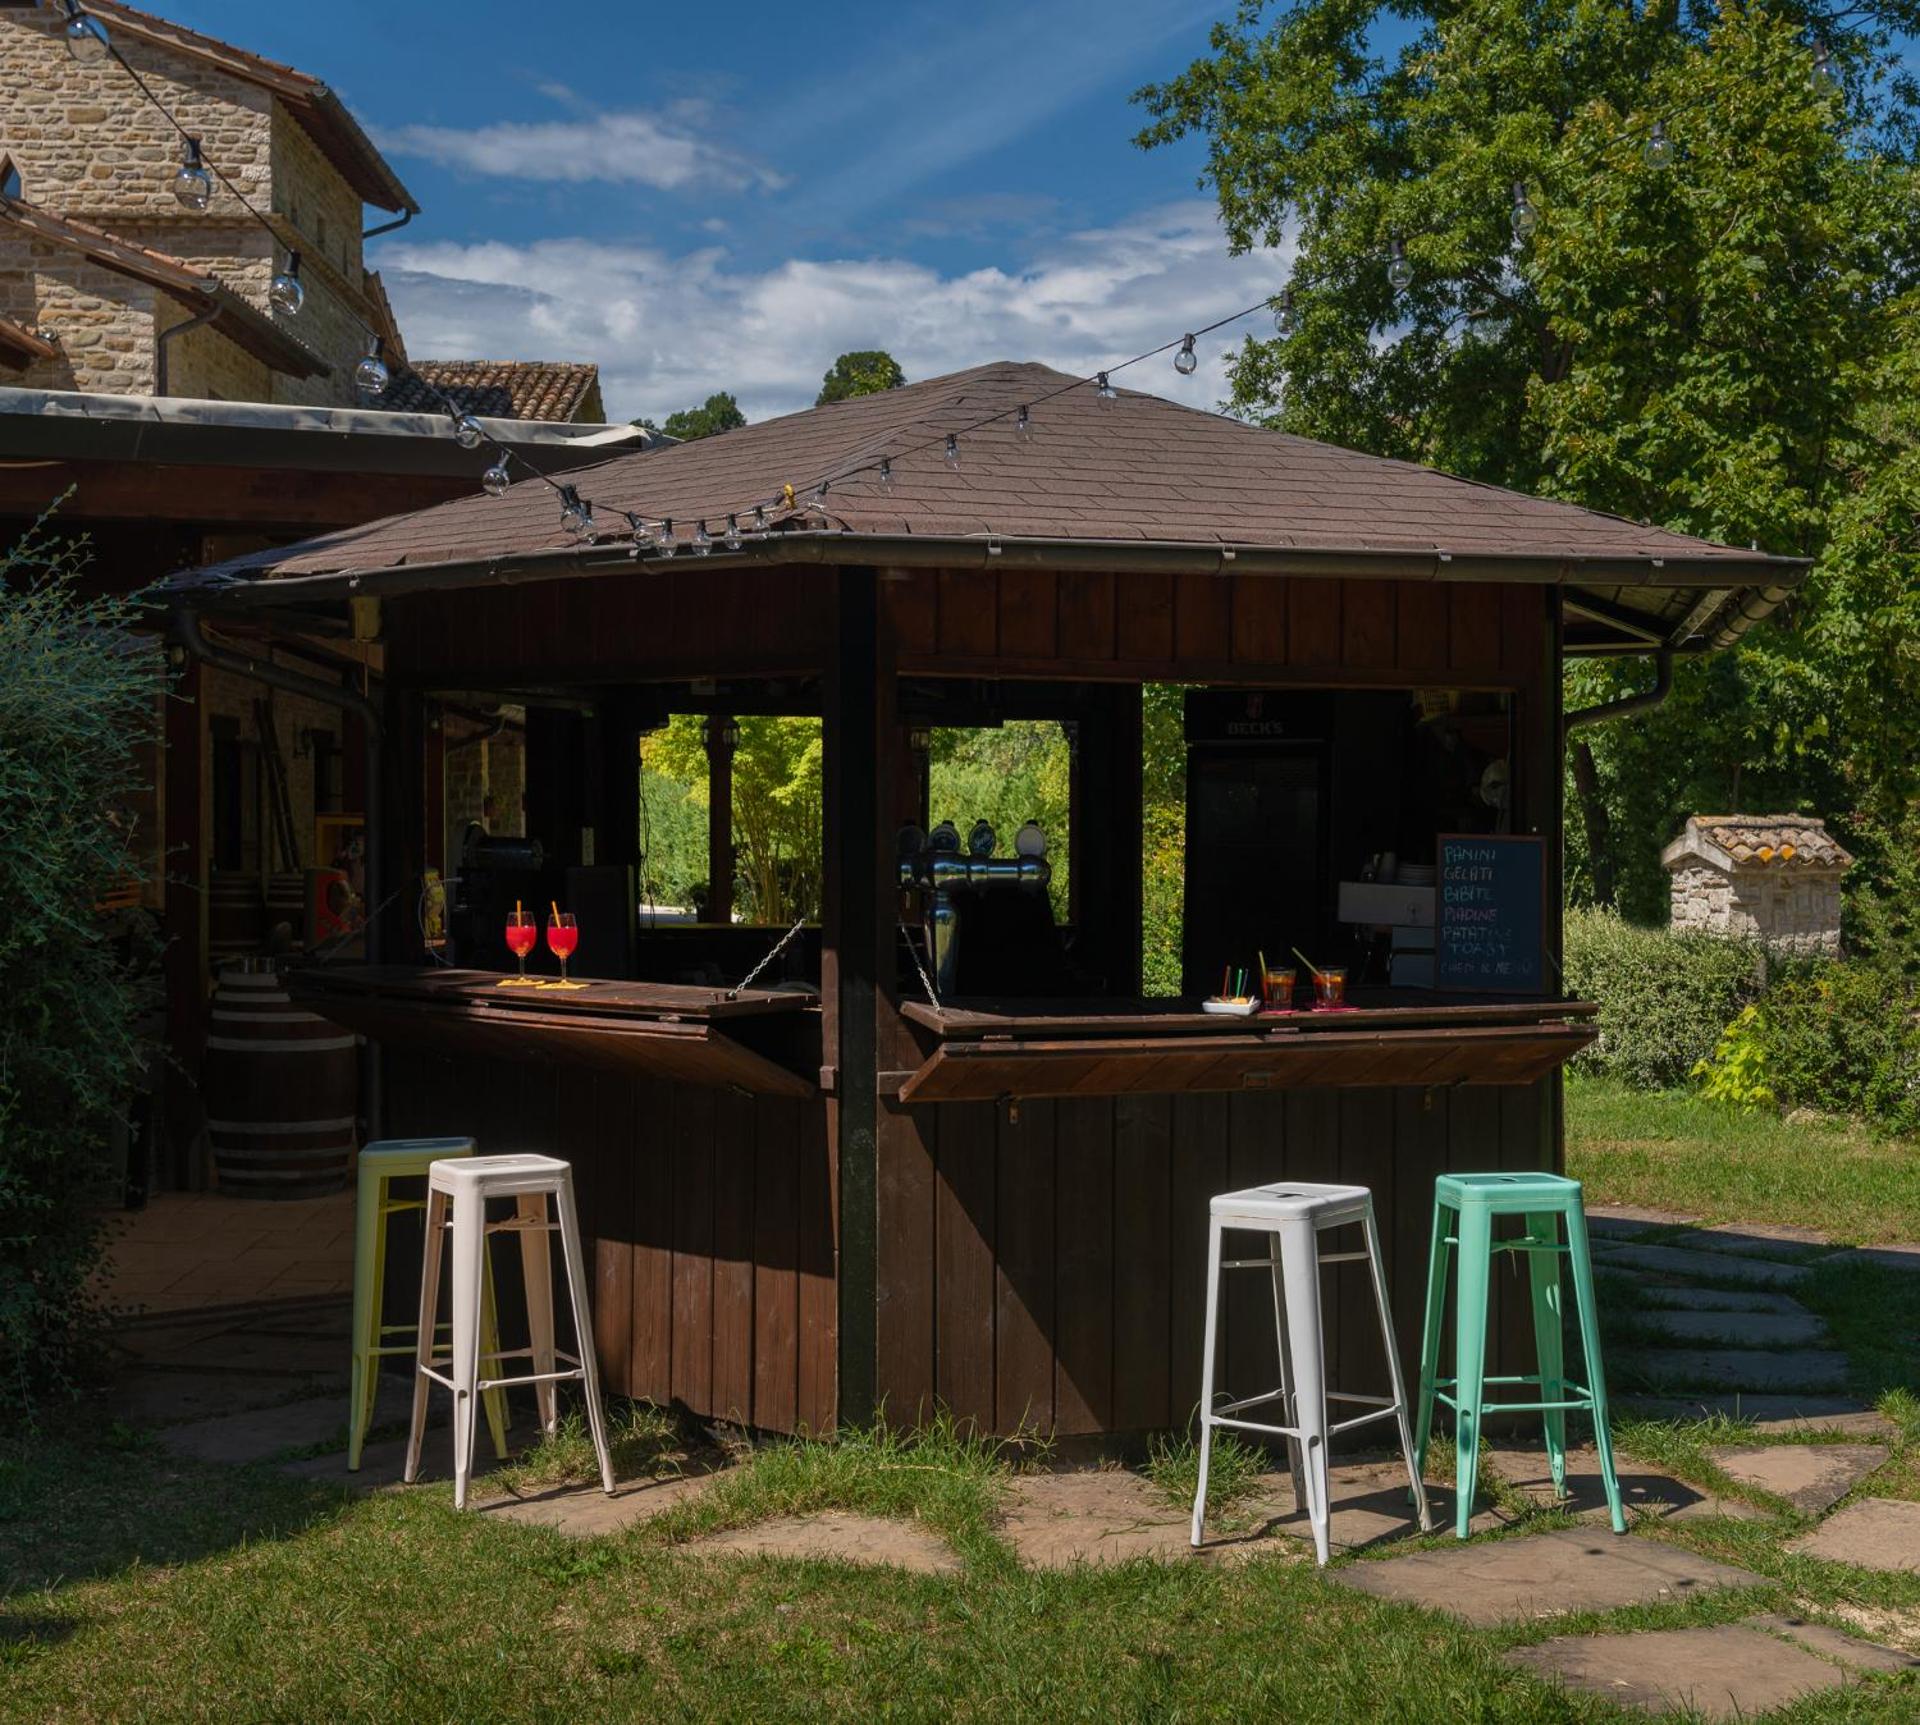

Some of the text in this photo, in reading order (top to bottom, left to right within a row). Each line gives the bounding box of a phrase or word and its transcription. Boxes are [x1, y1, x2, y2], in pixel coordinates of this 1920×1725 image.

[1444, 846, 1497, 863] PANINI
[1443, 866, 1494, 881] GELATI
[1443, 886, 1496, 903] BIBITE
[1444, 907, 1498, 922] PIADINE
[1448, 943, 1508, 957] TOAST
